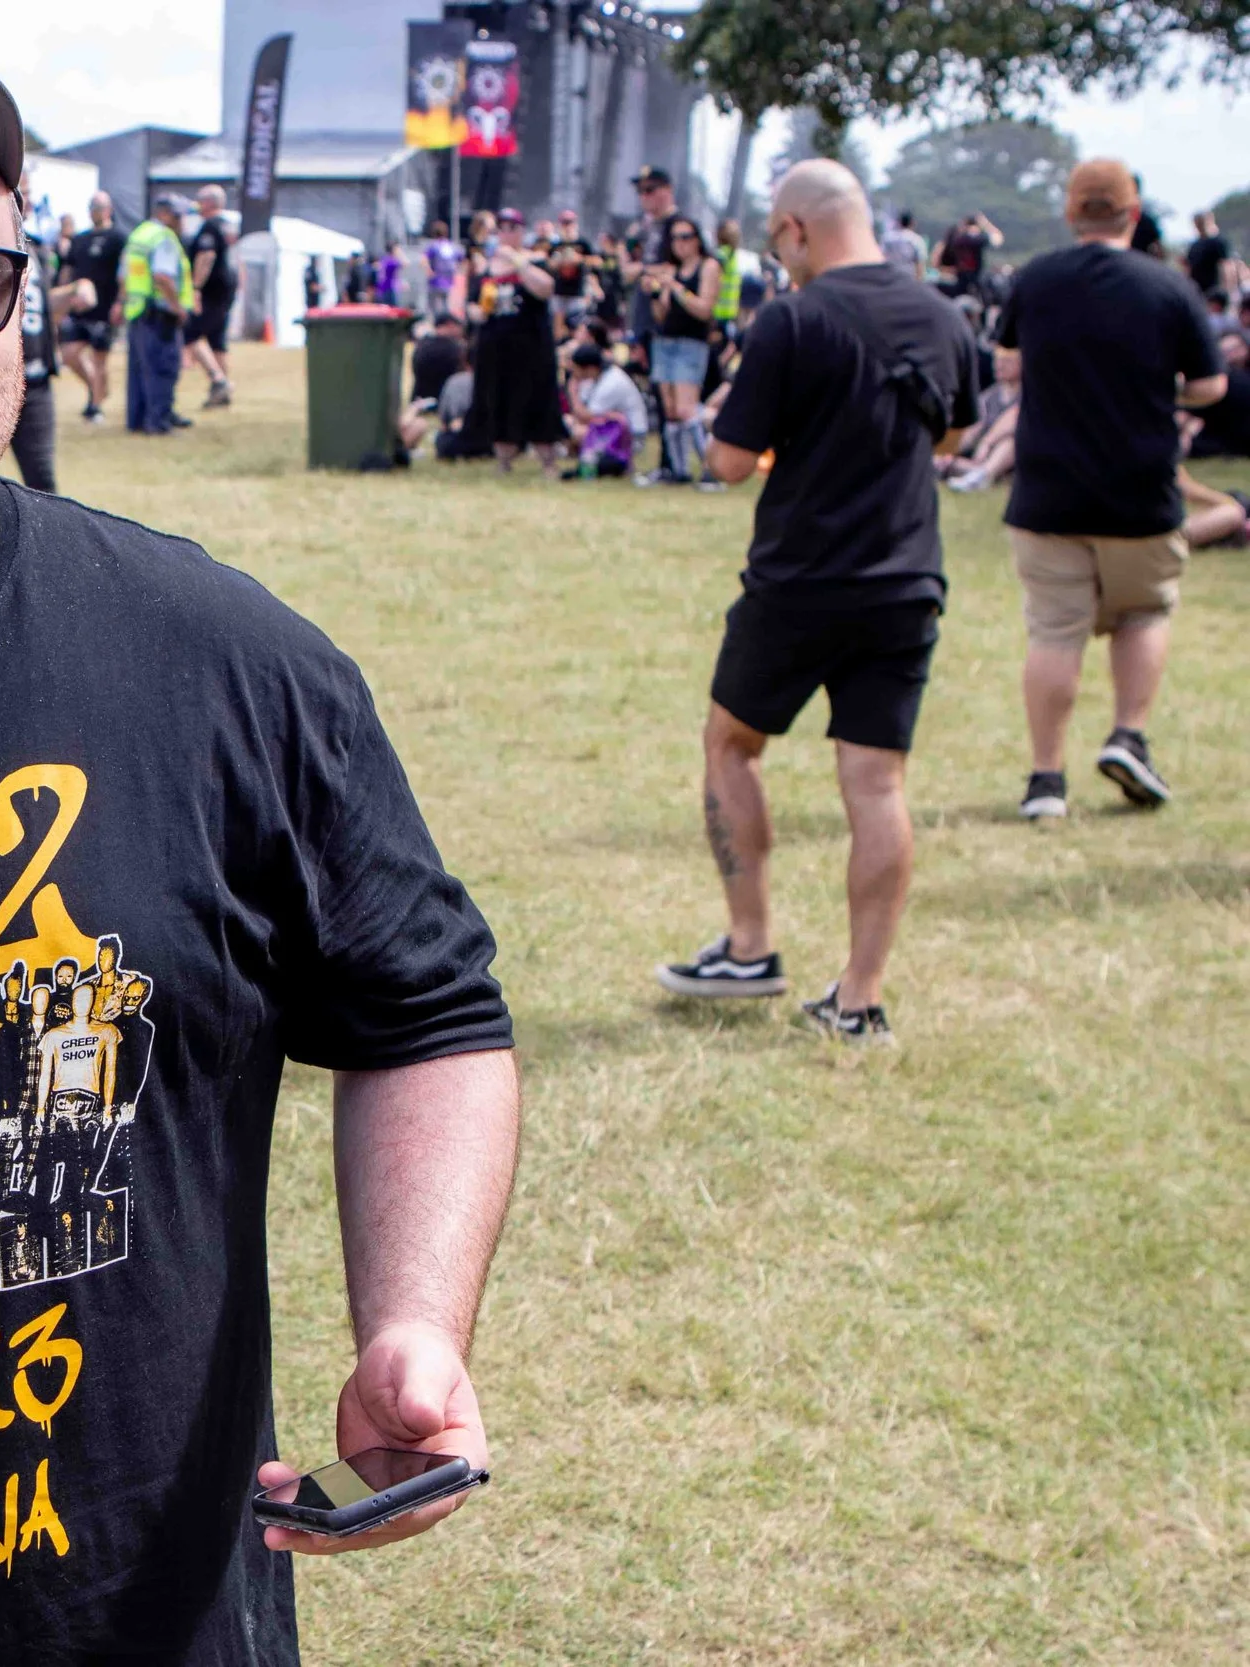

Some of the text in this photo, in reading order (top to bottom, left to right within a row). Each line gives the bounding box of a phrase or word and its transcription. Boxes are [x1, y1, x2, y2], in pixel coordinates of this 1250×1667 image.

[246, 79, 280, 200] MEDICAL
[61, 1036, 99, 1050] CREEP
[62, 1048, 97, 1062] SHOW
